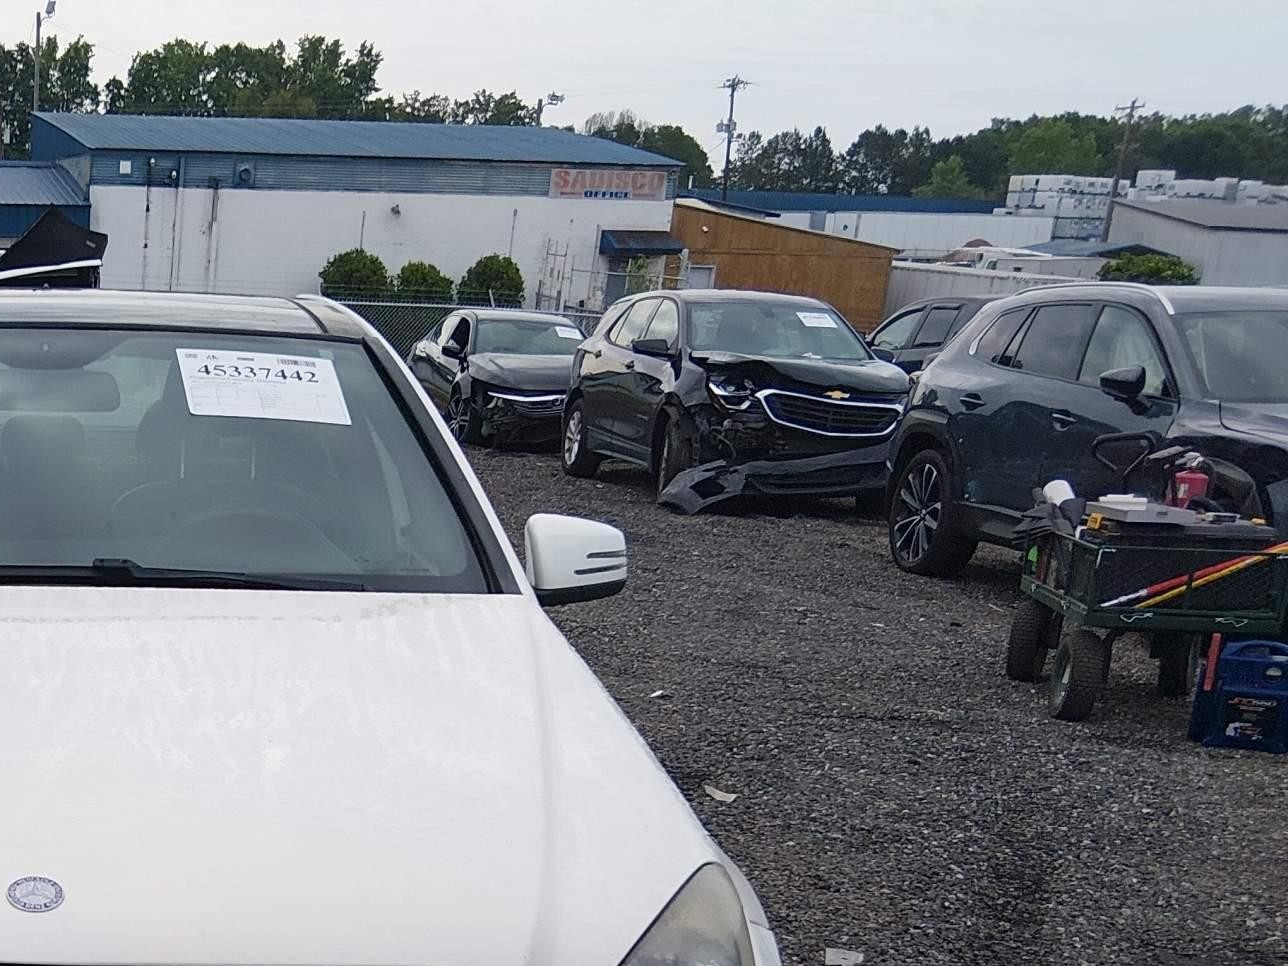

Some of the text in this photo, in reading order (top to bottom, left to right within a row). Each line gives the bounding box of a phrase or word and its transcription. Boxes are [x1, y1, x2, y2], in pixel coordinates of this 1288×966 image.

[554, 171, 664, 190] SADISCO
[583, 190, 631, 198] OFFICE
[197, 364, 319, 383] 45337442
